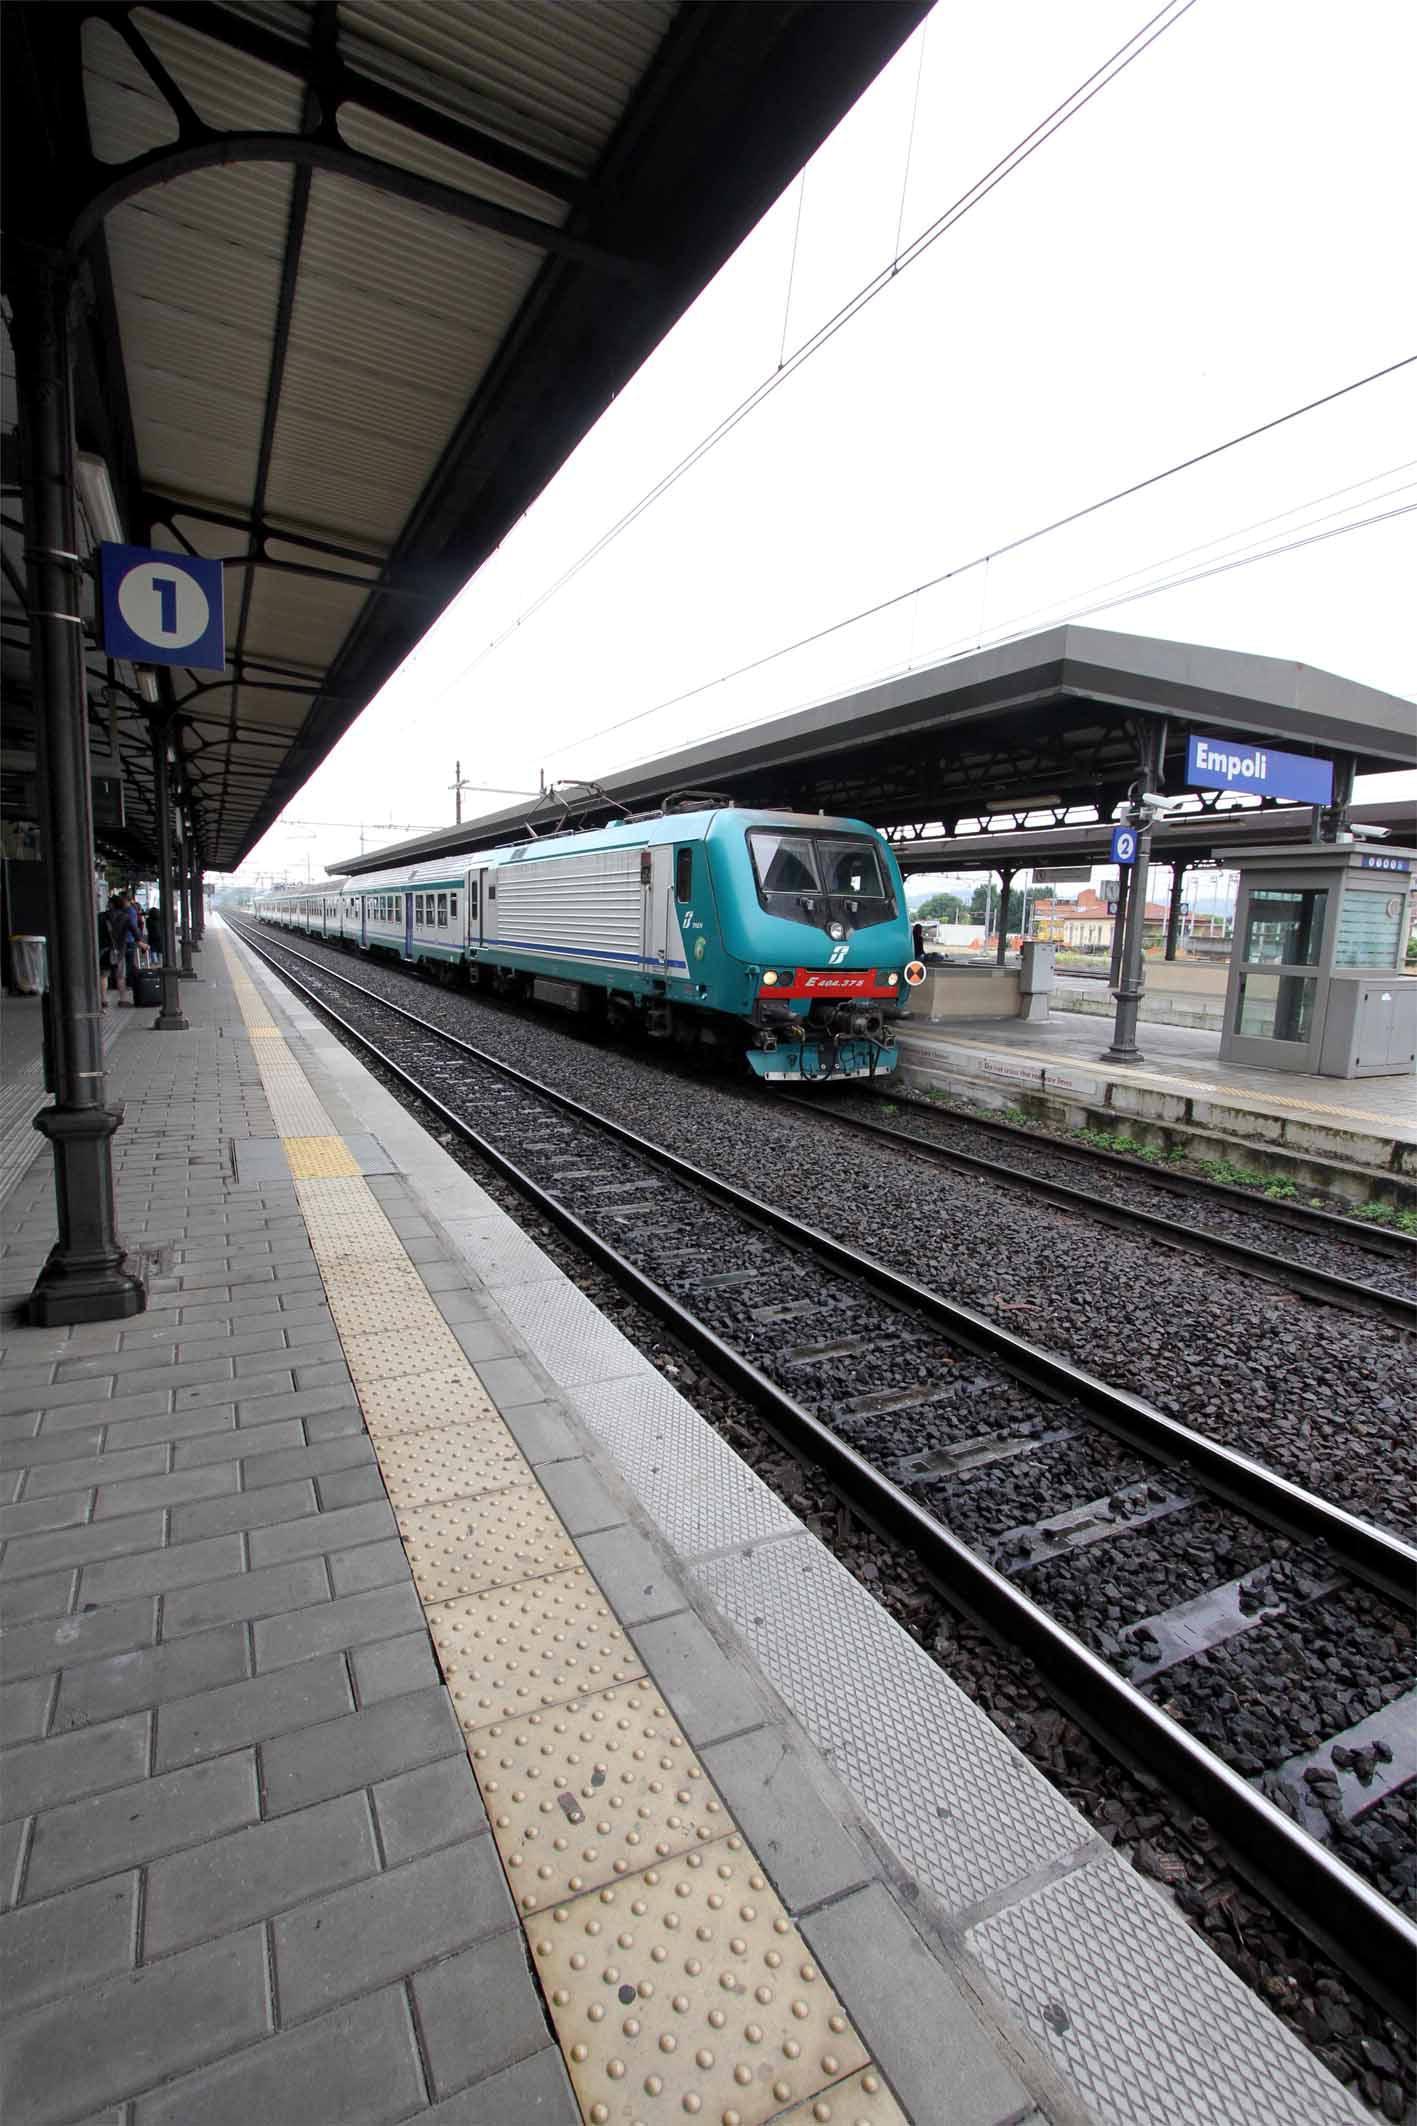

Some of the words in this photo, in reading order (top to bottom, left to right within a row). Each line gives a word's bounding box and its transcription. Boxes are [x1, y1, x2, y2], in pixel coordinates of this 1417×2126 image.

[151, 576, 178, 635] 1
[1196, 741, 1267, 781] Empoli
[1120, 838, 1130, 855] 2
[805, 977, 819, 986] E
